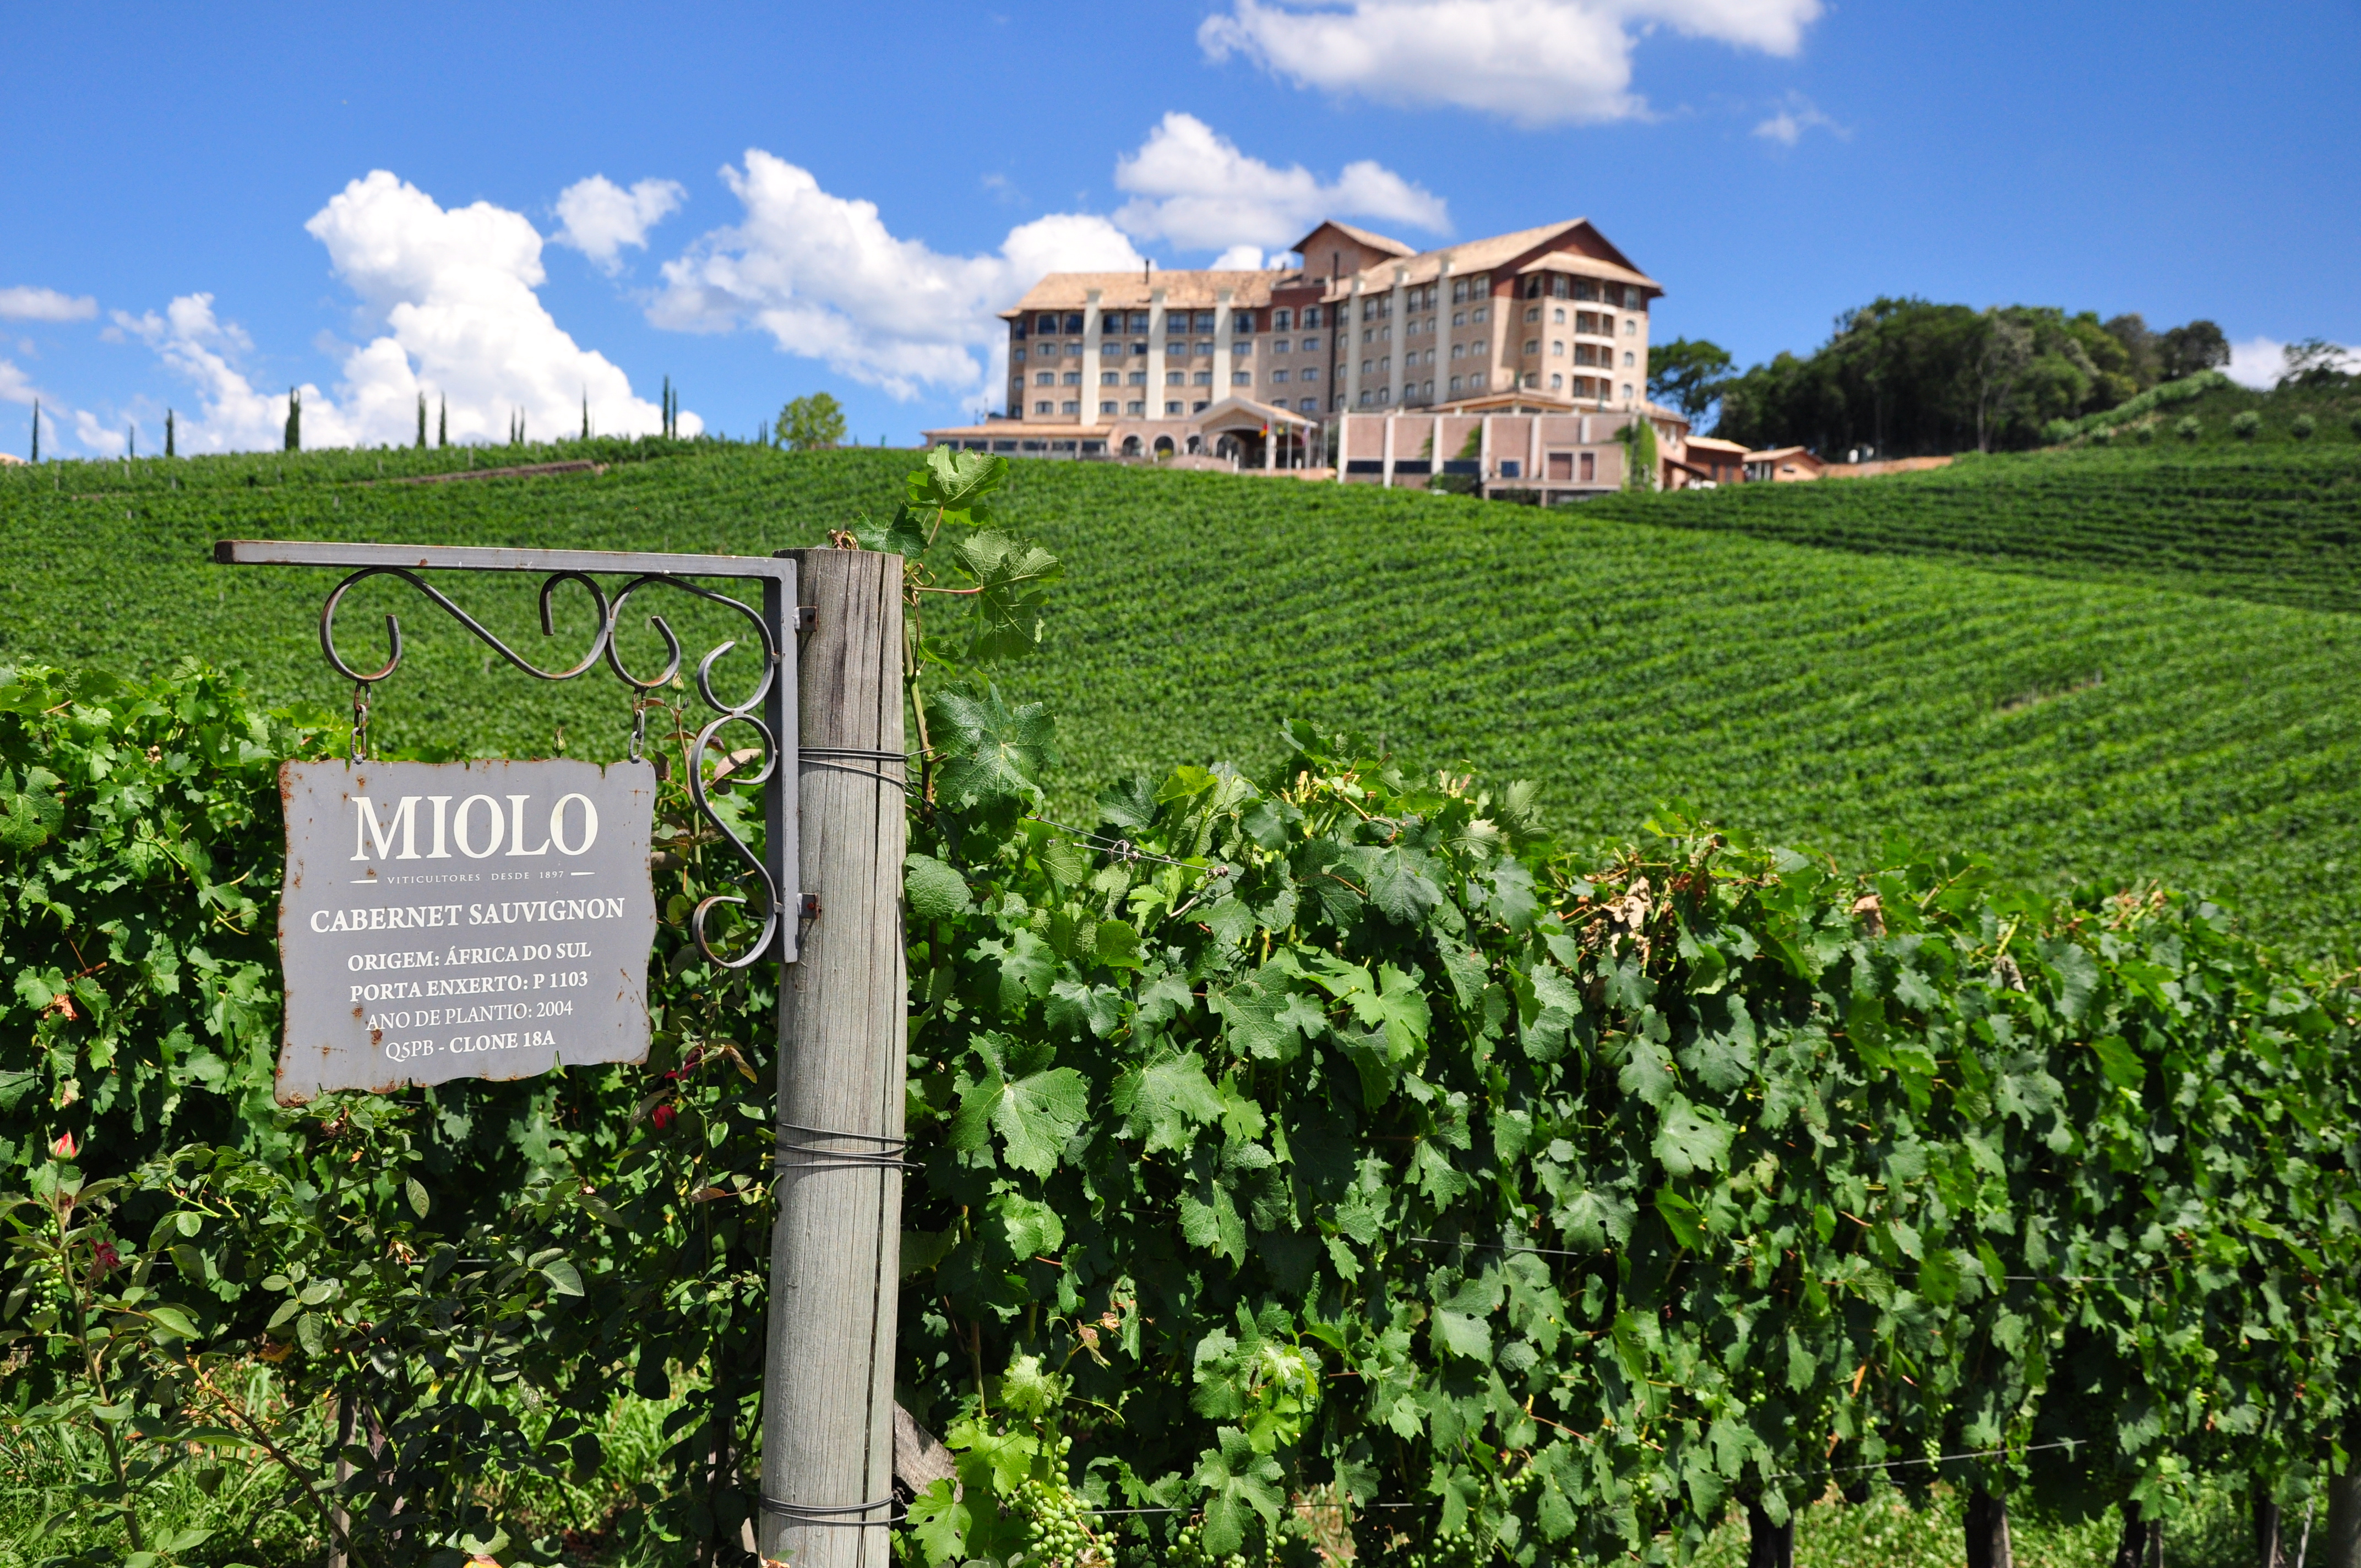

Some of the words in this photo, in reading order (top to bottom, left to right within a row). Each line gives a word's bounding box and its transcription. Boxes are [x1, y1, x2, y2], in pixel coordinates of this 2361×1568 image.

[350, 793, 599, 861] MIOLO
[387, 874, 480, 884] VITICULTORES
[491, 872, 529, 880] DESDE
[540, 870, 564, 879] 1897
[311, 905, 463, 933] CABERNET
[469, 897, 625, 925] SAUVIGNON
[347, 951, 439, 971] ORIGEM:
[444, 945, 519, 966] ÁFRICA
[522, 944, 552, 961] DO
[556, 942, 592, 959] SUL
[350, 982, 423, 1002] PORTA
[426, 974, 528, 997] ENXERTO:
[532, 973, 545, 989] P
[550, 971, 588, 988] 1103
[365, 1011, 410, 1031] ANO
[414, 1009, 441, 1027] DE
[445, 1003, 532, 1025] PLANTIO:
[536, 1000, 573, 1017] 2004
[385, 1039, 434, 1063] Q5PB
[449, 1032, 518, 1053] CLONE
[523, 1030, 556, 1047] 18A
